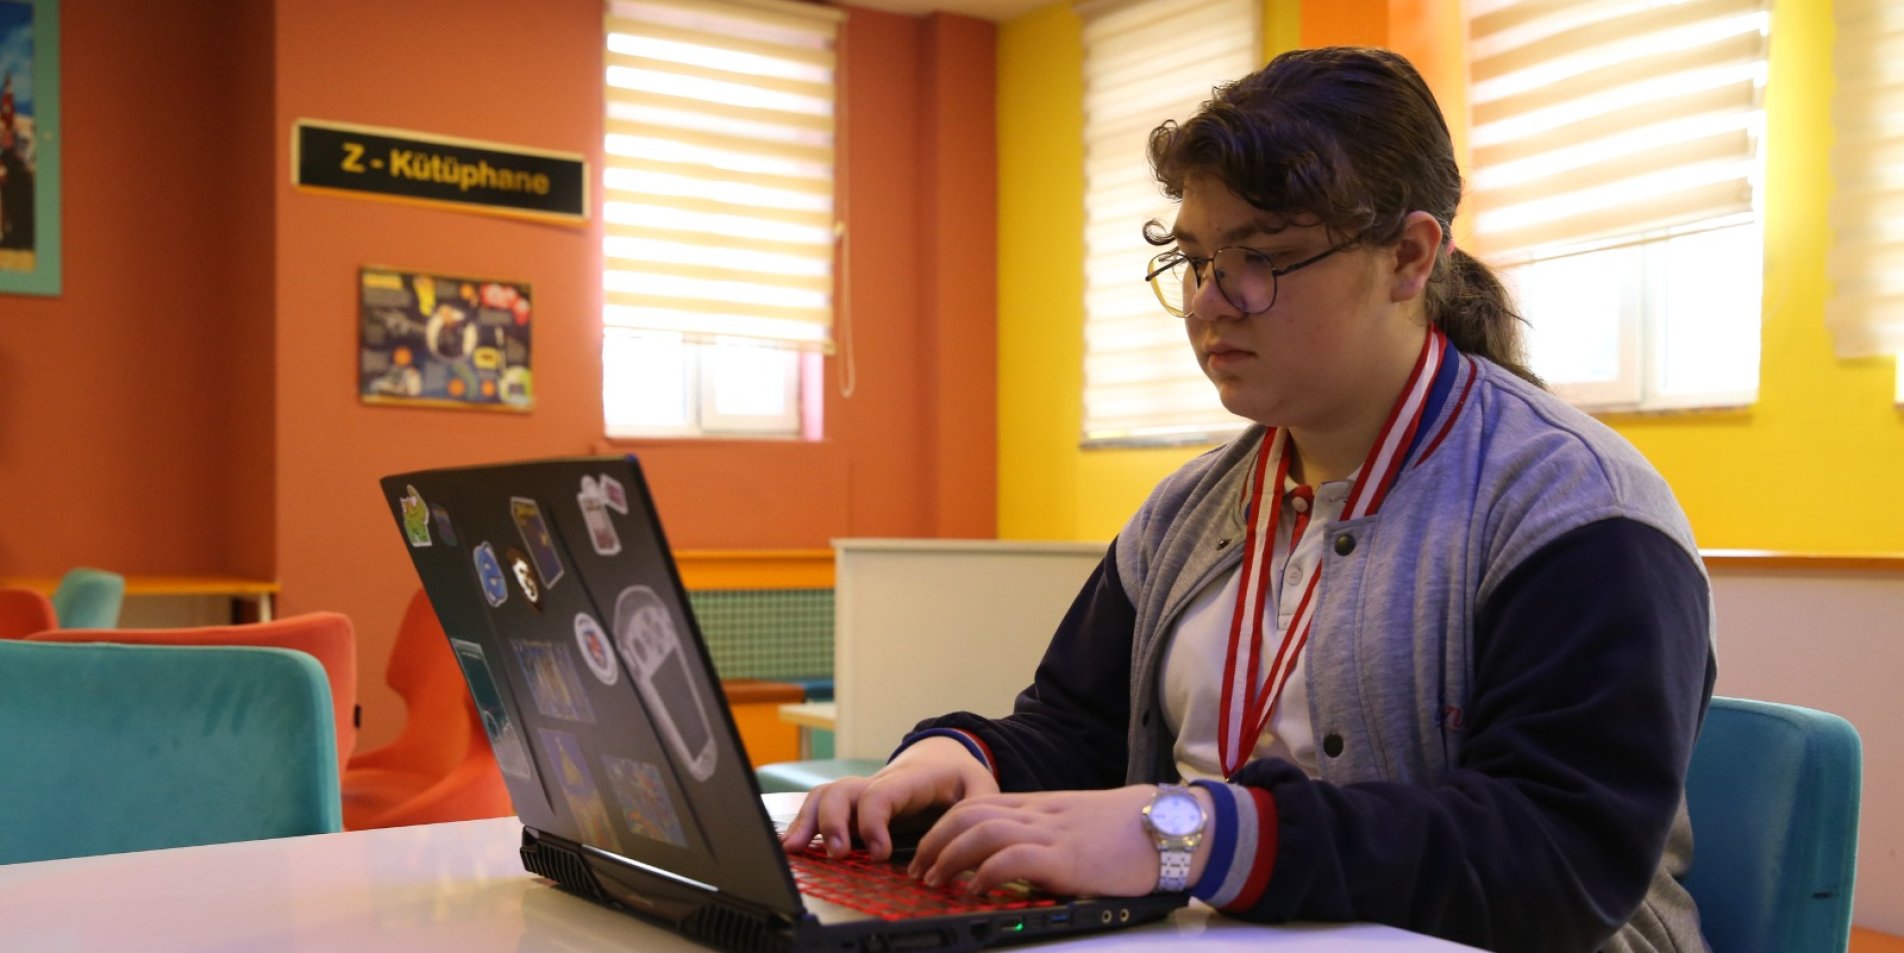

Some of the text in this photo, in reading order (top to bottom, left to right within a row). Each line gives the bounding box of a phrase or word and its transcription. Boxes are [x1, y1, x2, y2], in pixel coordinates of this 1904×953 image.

[341, 143, 549, 195] Z - Kütüphane
